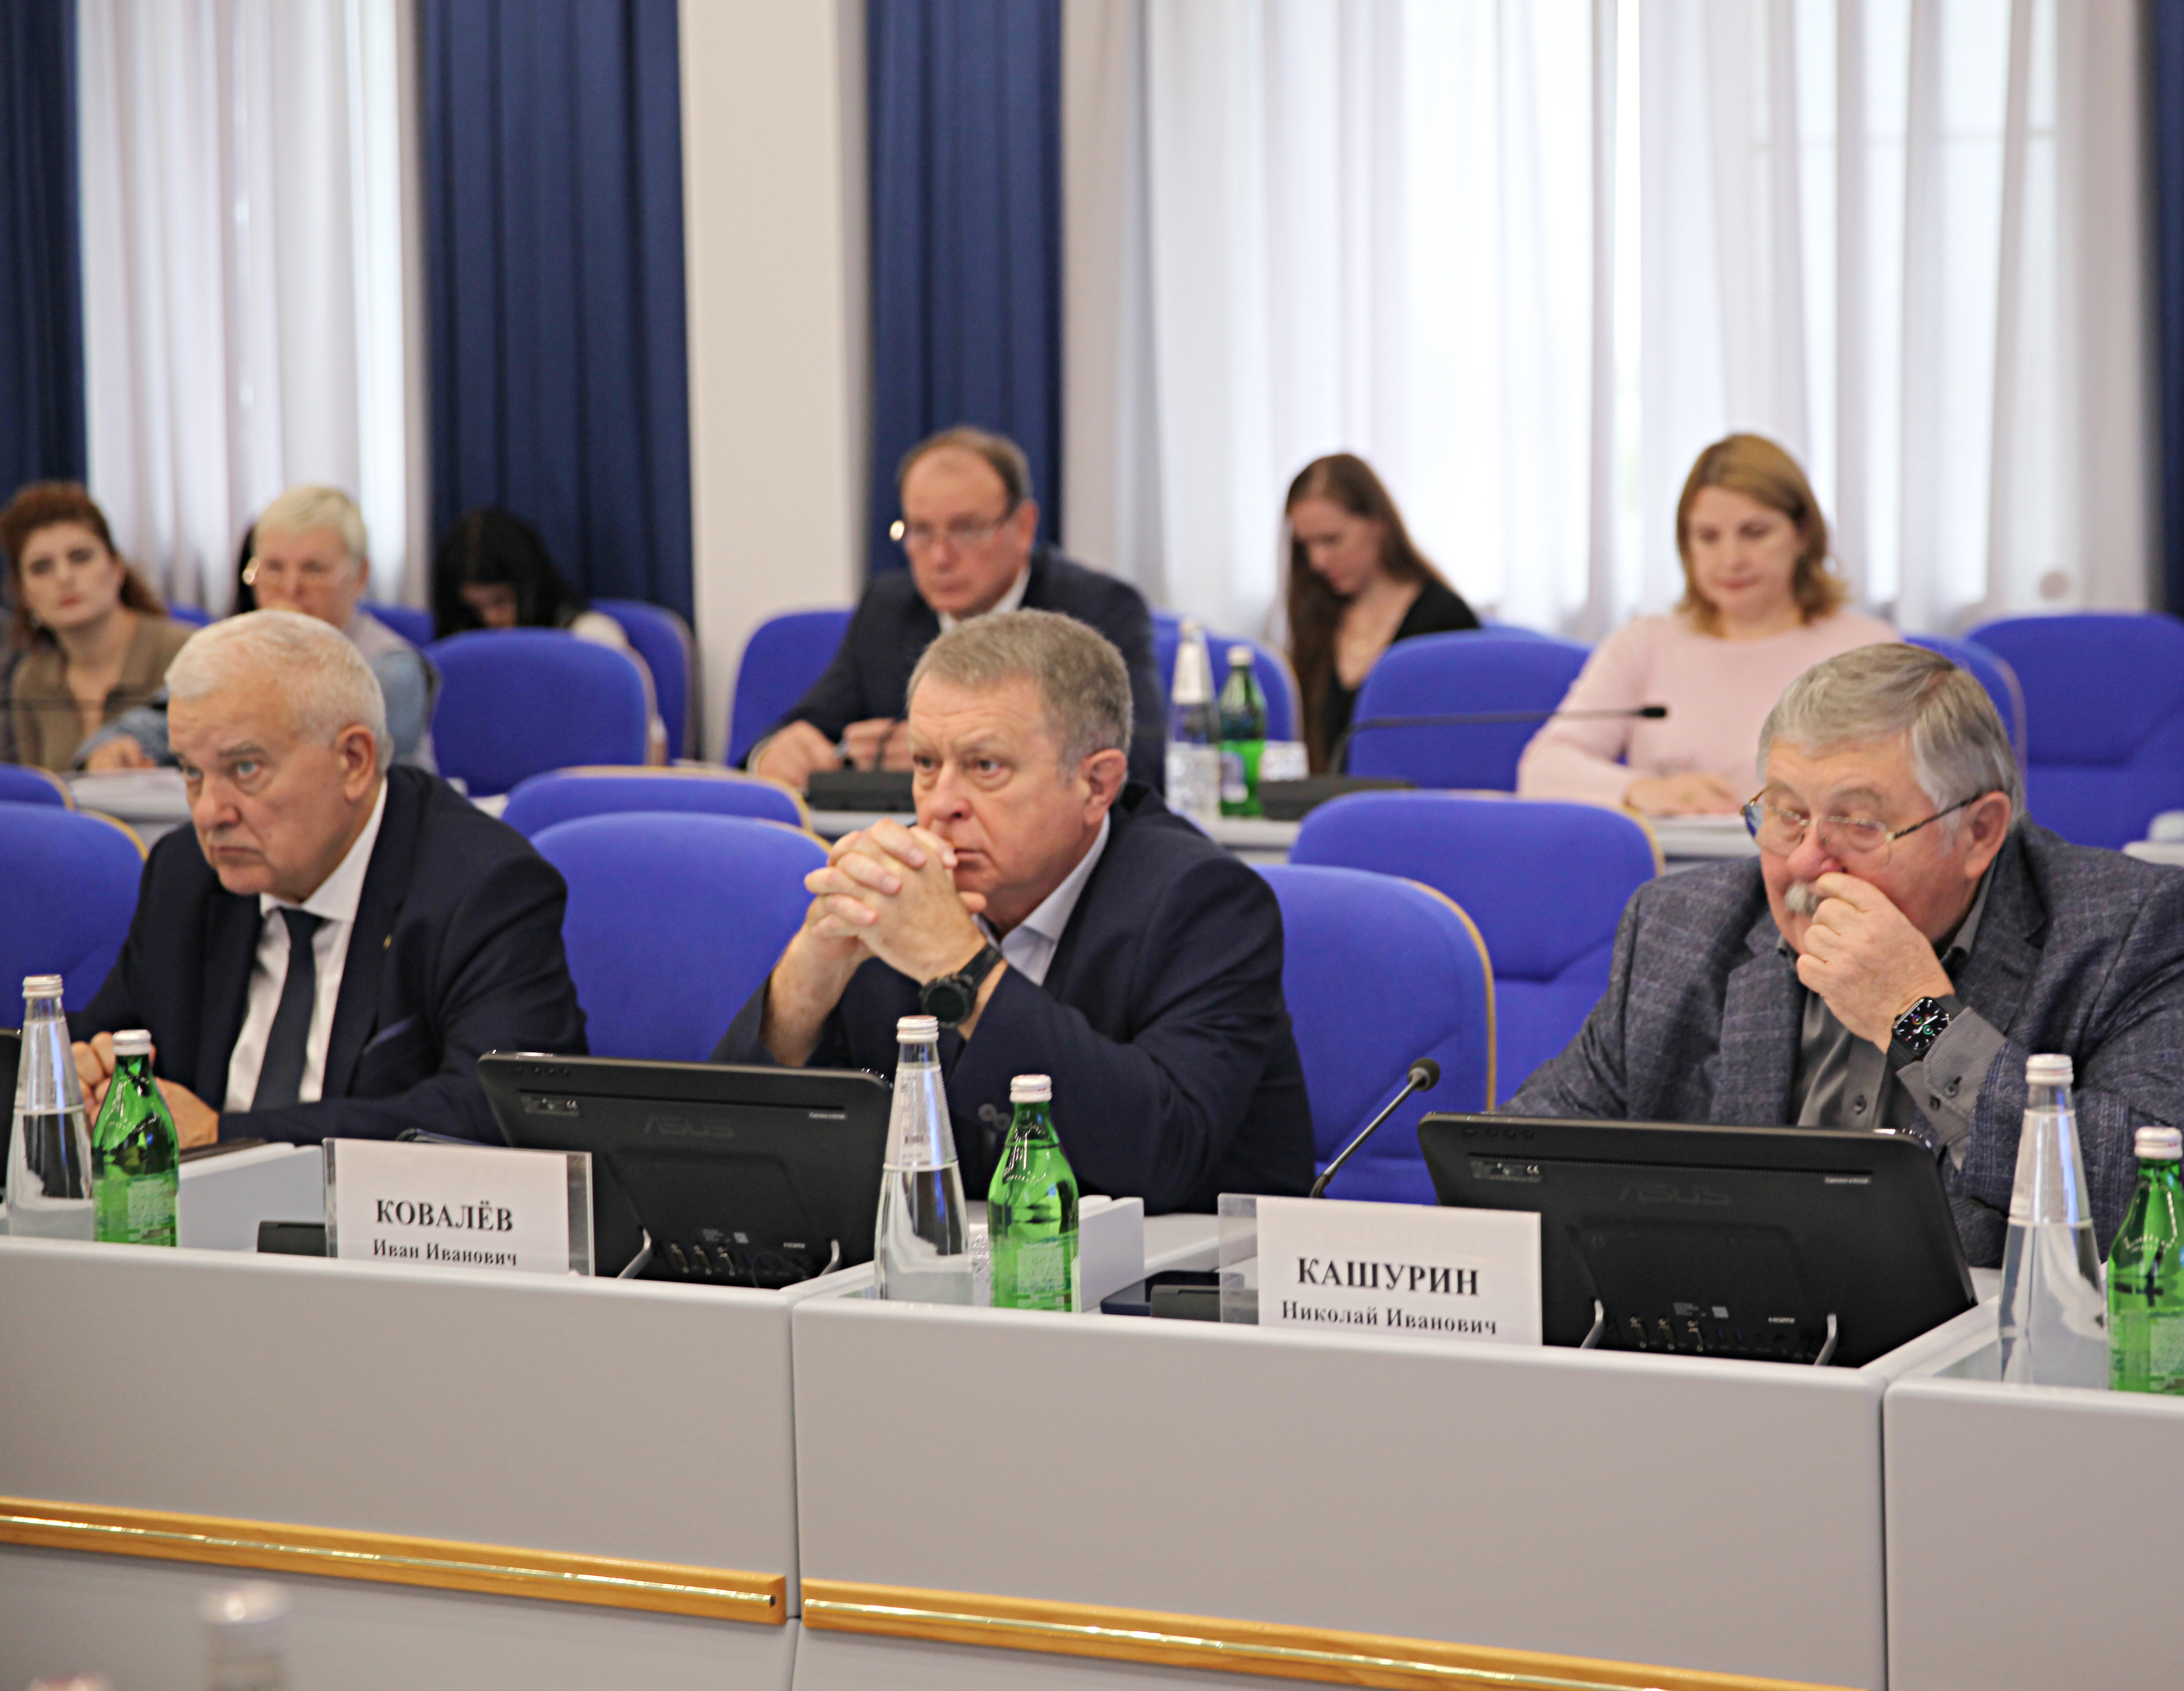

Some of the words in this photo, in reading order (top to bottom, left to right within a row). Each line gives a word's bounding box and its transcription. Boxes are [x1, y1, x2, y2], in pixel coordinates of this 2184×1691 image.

[376, 1199, 514, 1232] КОВАЛЁВ
[373, 1239, 419, 1259] Иван
[426, 1243, 517, 1267] Иванович
[1297, 1257, 1478, 1296] КАШУРИН
[1282, 1300, 1378, 1326] Николай
[1386, 1308, 1497, 1335] Иванович
